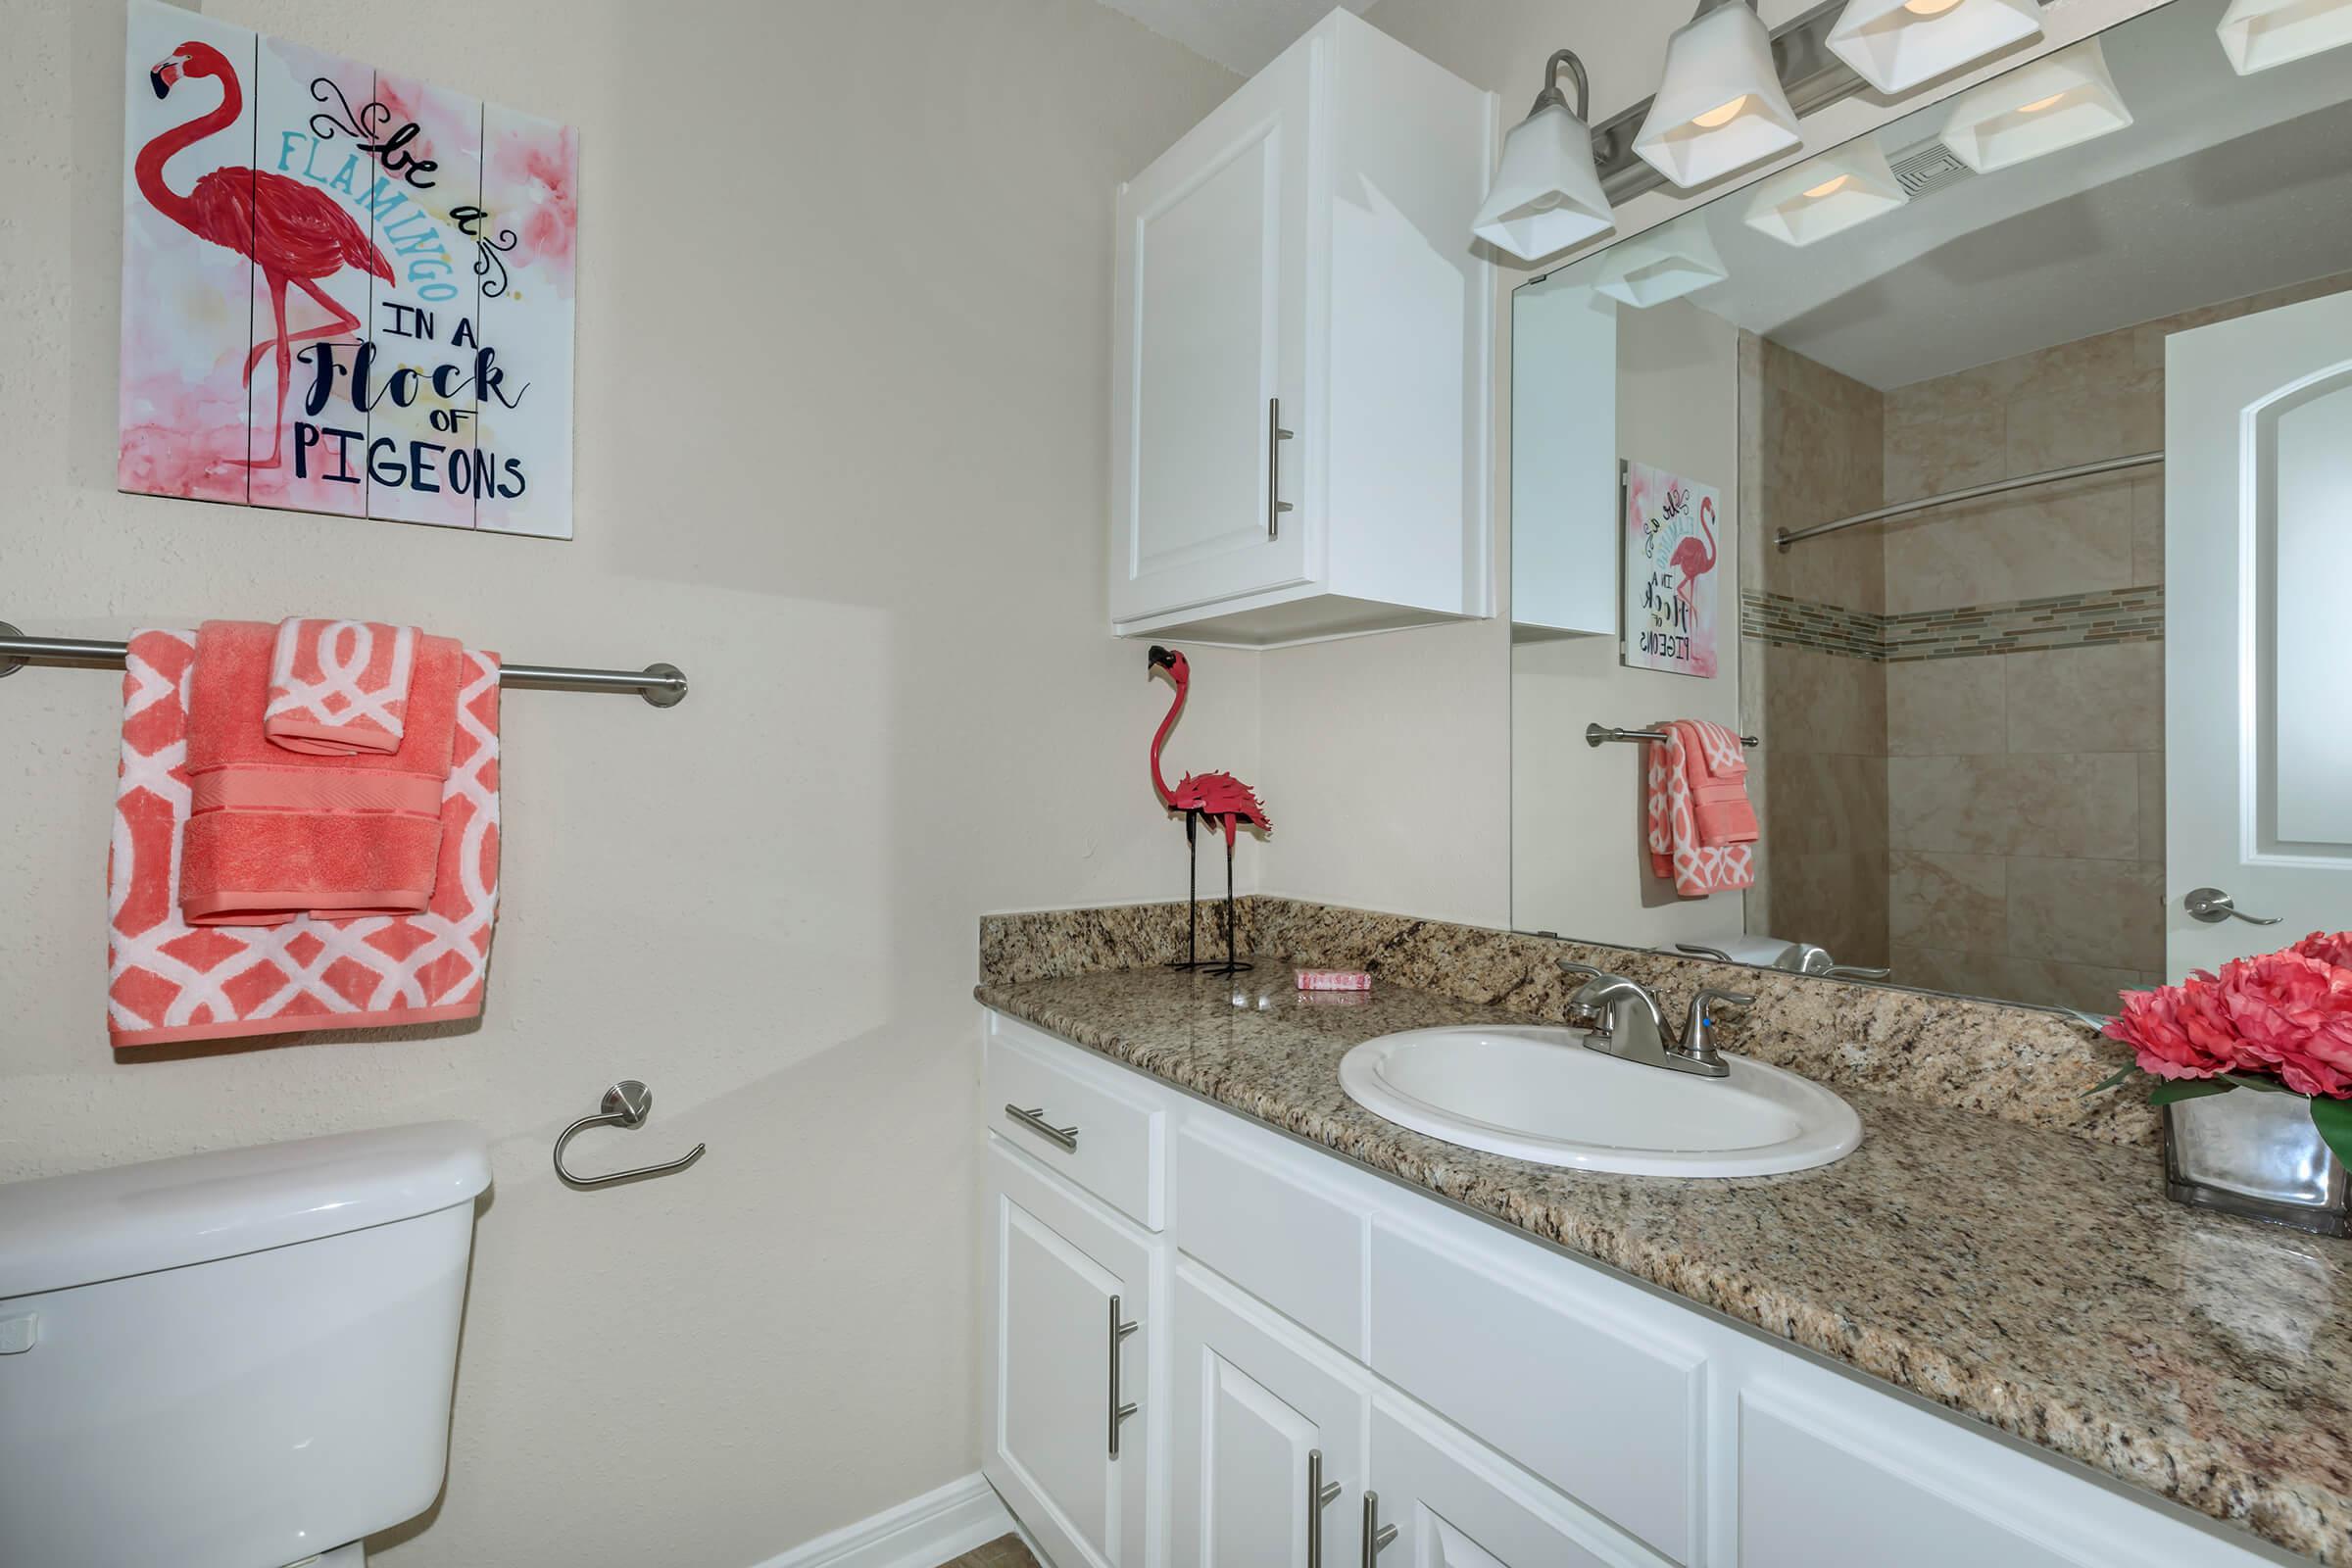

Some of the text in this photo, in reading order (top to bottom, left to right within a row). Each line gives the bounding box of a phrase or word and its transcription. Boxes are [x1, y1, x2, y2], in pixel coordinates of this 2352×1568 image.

[277, 130, 459, 303] FLAMINGO
[358, 122, 488, 236] be a
[382, 301, 478, 350] IN A
[297, 337, 531, 416] Flock
[294, 421, 527, 500] PIGEONS
[429, 409, 478, 434] OF
